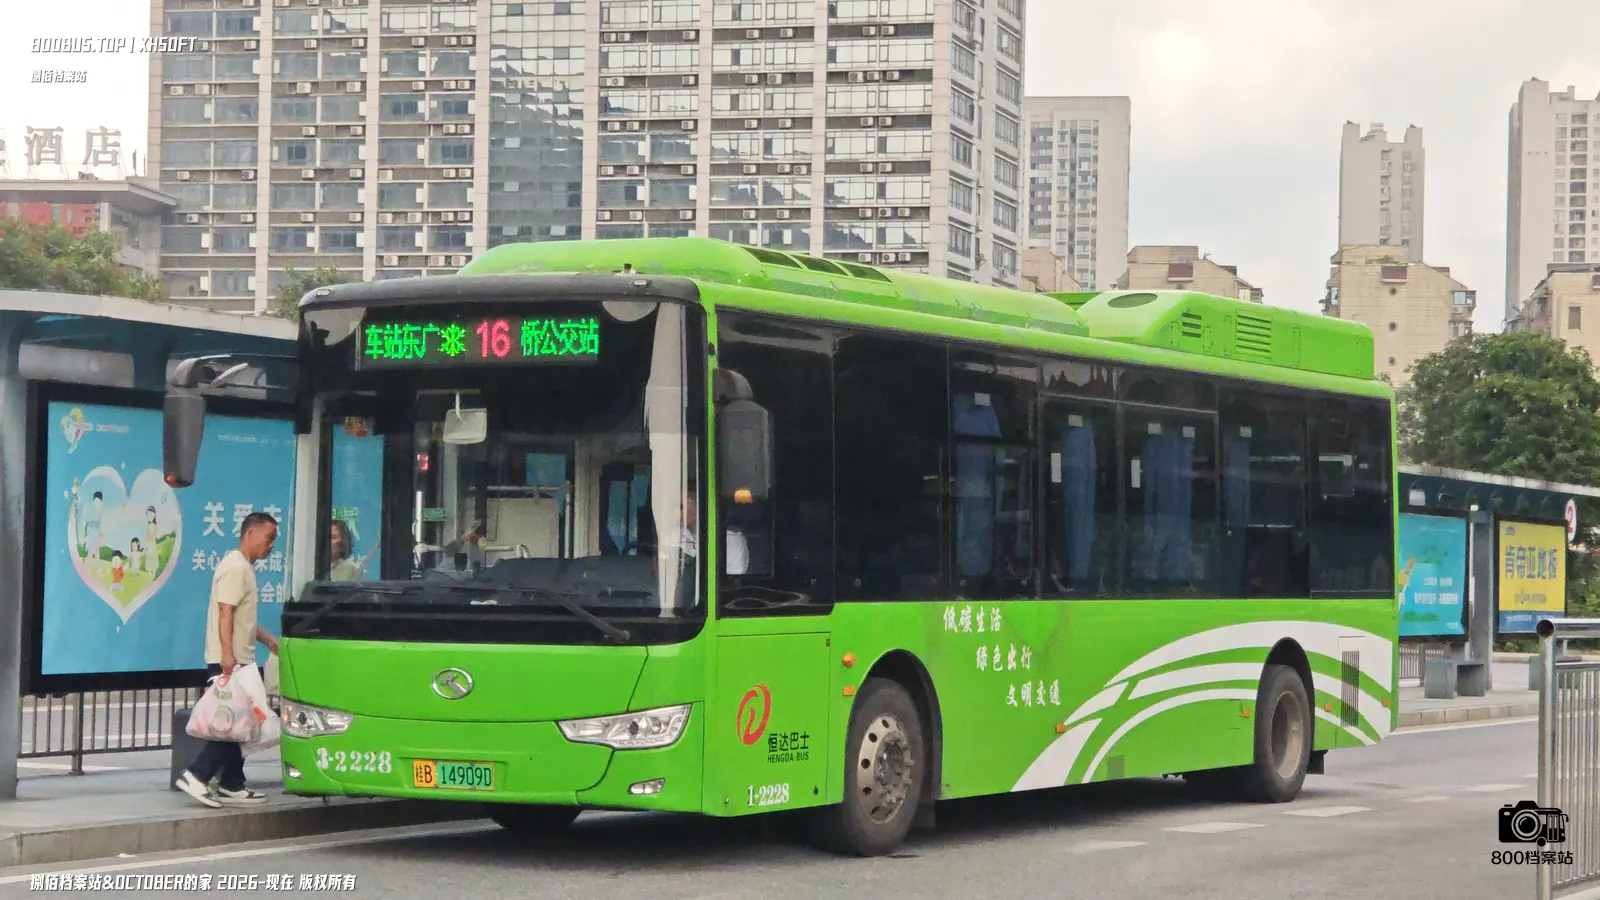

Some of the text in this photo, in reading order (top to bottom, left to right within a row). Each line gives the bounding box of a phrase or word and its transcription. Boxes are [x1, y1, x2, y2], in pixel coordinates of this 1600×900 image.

[0, 125, 122, 167] 酒店
[476, 320, 511, 358] 16
[521, 318, 599, 356] 桥公交站
[943, 604, 1001, 633] 低碳生活
[976, 643, 1032, 671] 绿色出行
[1006, 679, 1061, 708] 文明交通
[768, 731, 810, 752] 恒达巴士
[768, 751, 809, 764] HENGDA BUS
[747, 783, 790, 807] 1-2228
